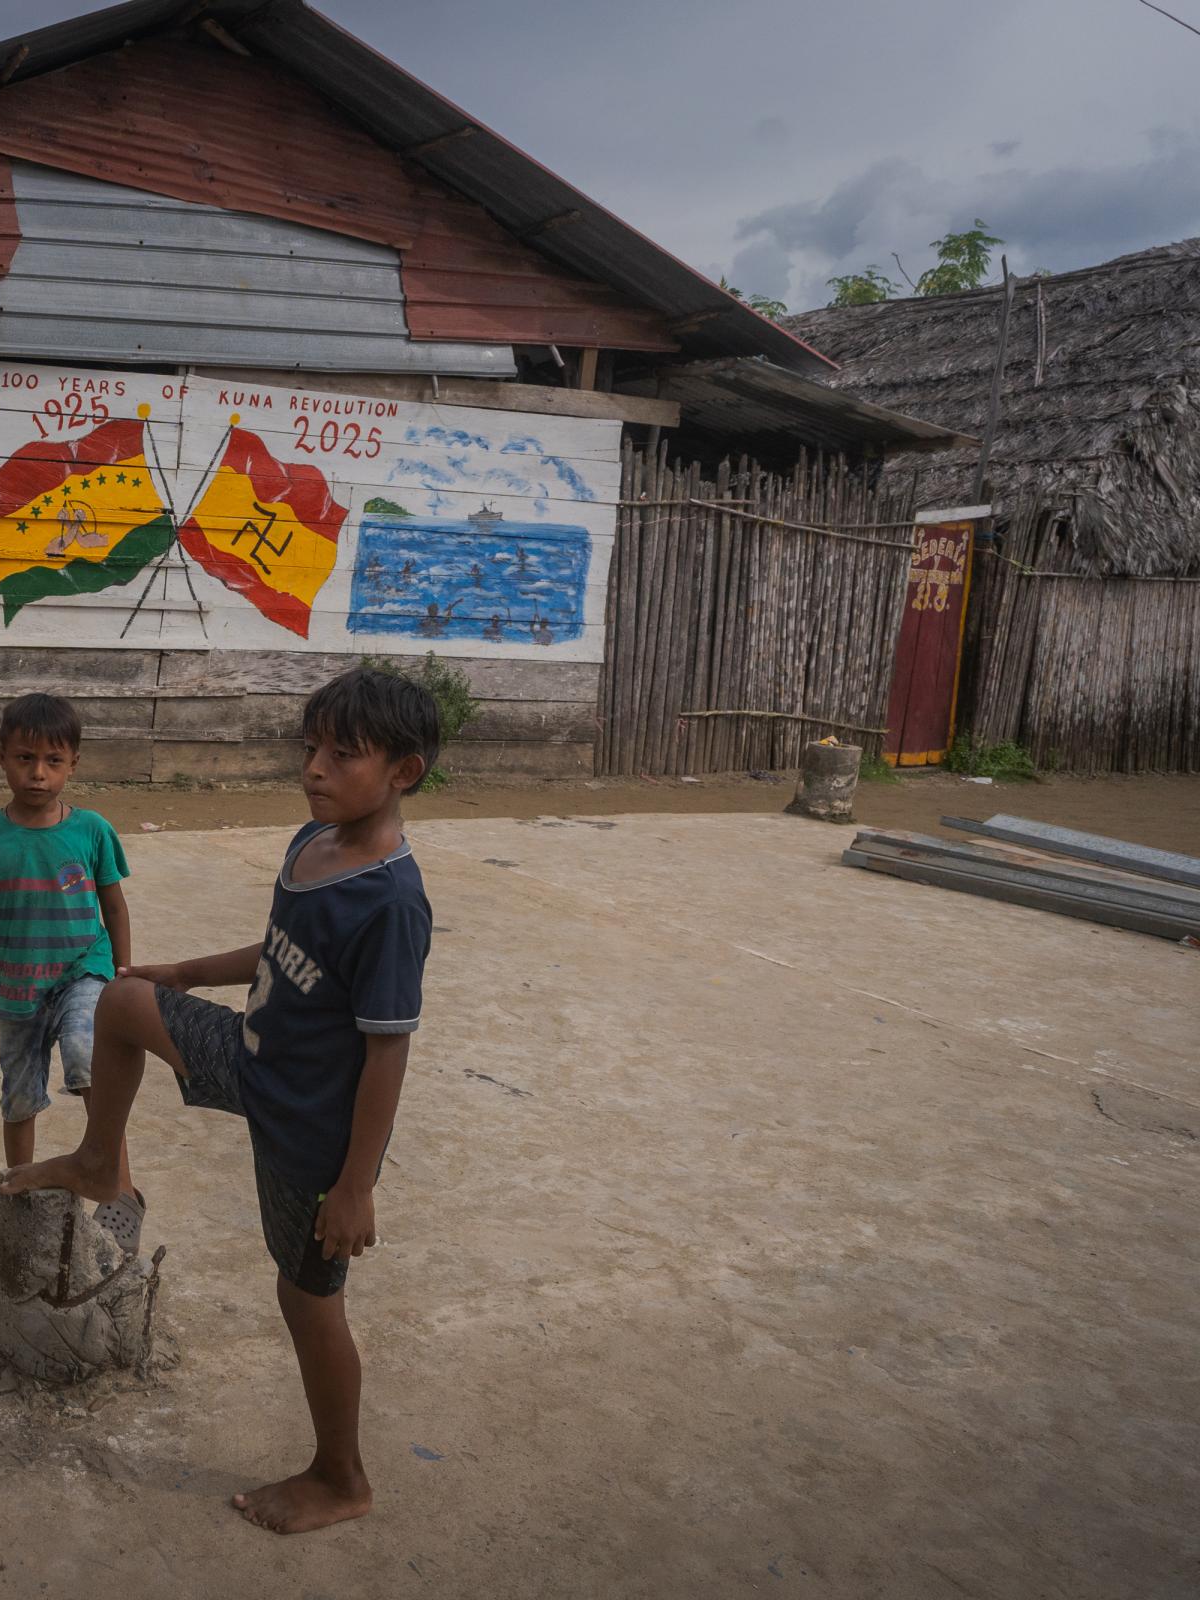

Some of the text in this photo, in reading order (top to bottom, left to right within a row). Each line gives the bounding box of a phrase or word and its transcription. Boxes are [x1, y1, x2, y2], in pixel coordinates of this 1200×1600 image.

[1, 372, 399, 417] 100 YEARS OF KUNA REVOLUTION
[32, 392, 110, 439] 1925
[293, 415, 383, 459] 2025
